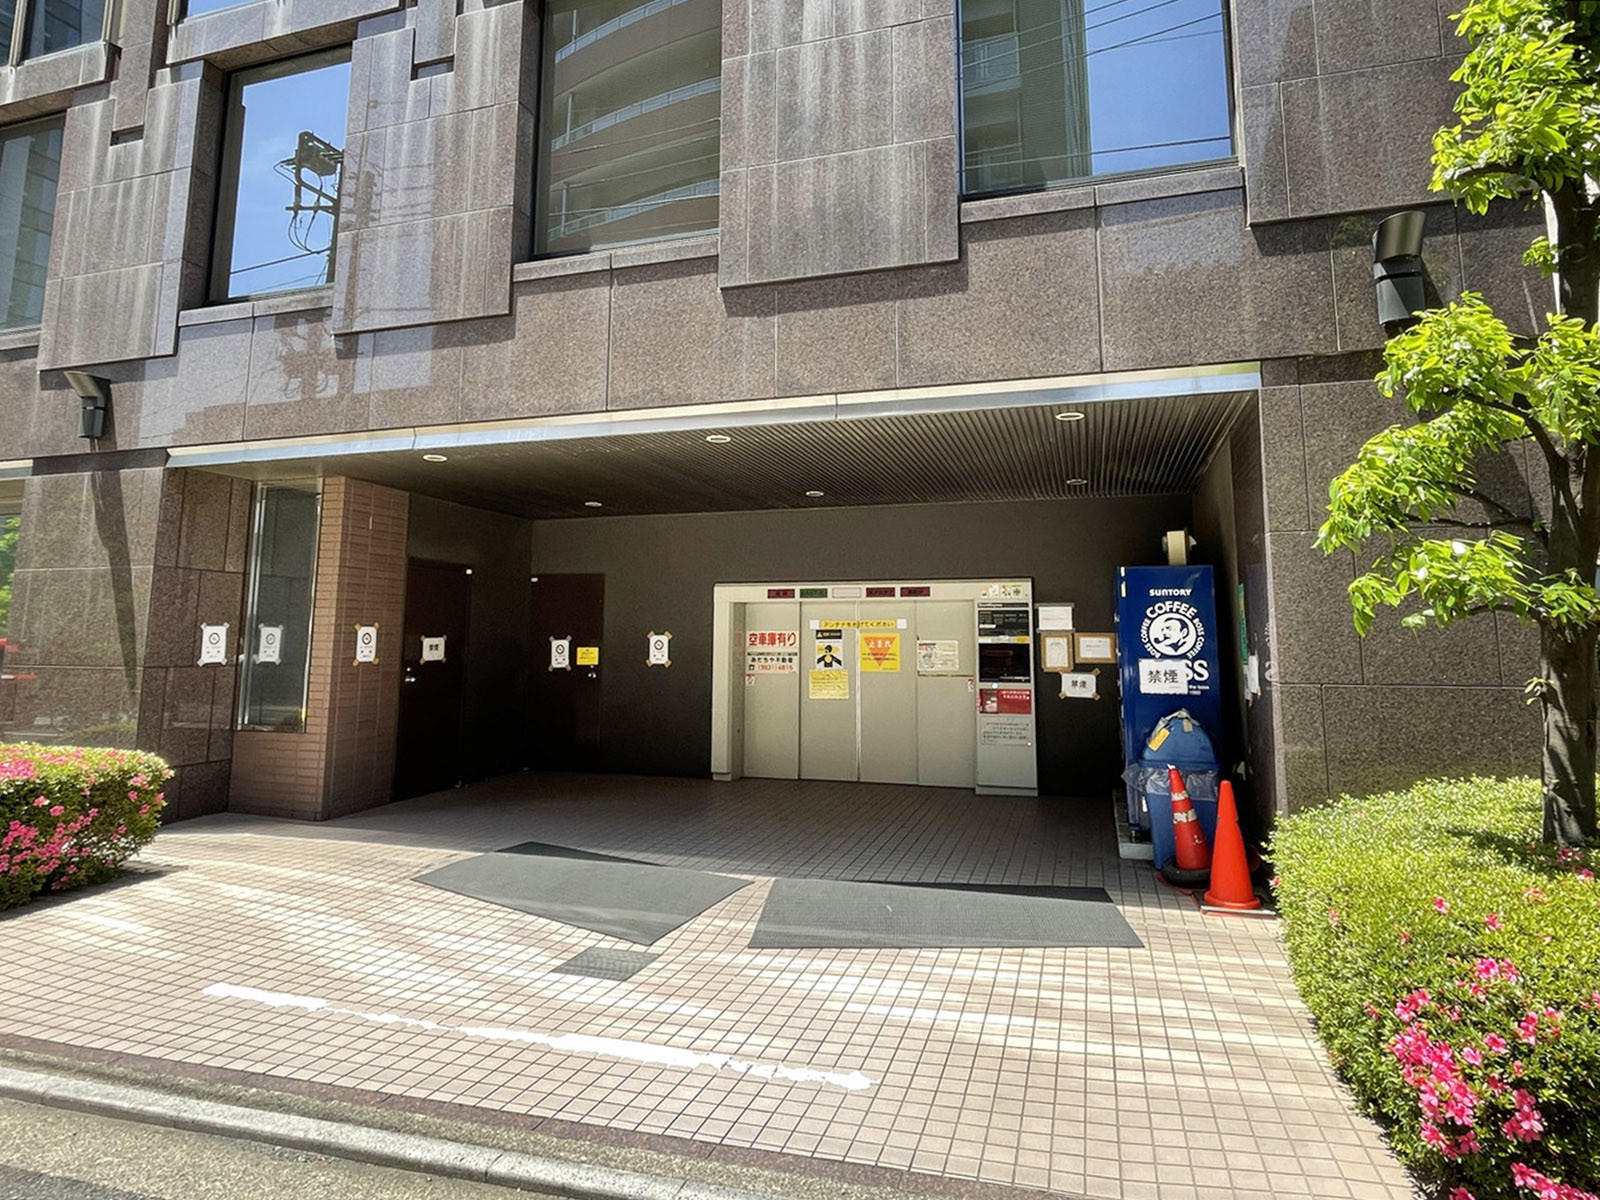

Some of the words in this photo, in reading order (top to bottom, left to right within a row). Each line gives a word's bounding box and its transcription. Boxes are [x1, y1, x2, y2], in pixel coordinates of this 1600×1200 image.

[1149, 588, 1192, 597] SUNTORY
[1146, 600, 1198, 619] COFFEE
[749, 632, 797, 647] 空車庫有り
[1147, 669, 1179, 684] 禁煙
